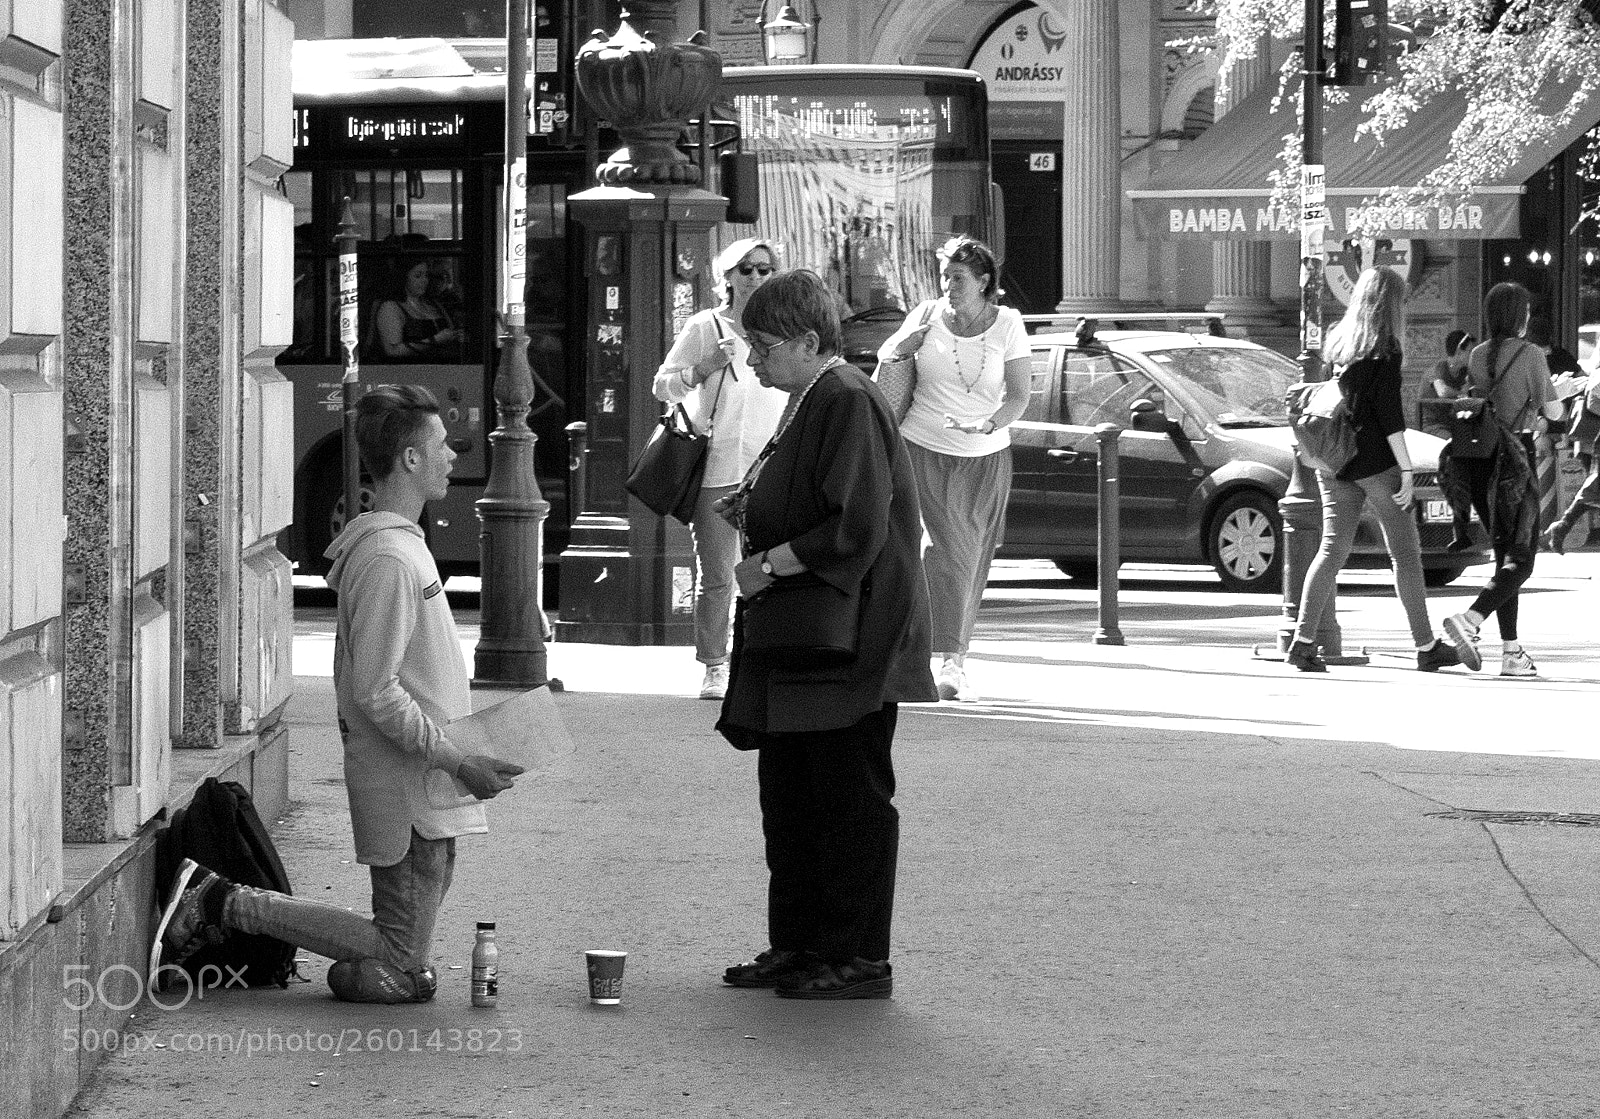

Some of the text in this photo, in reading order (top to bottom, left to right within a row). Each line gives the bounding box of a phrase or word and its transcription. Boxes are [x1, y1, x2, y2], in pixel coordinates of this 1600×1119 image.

[995, 62, 1064, 82] ANDRÁSSY
[1034, 155, 1050, 169] 46
[1169, 207, 1247, 233] BAMBA
